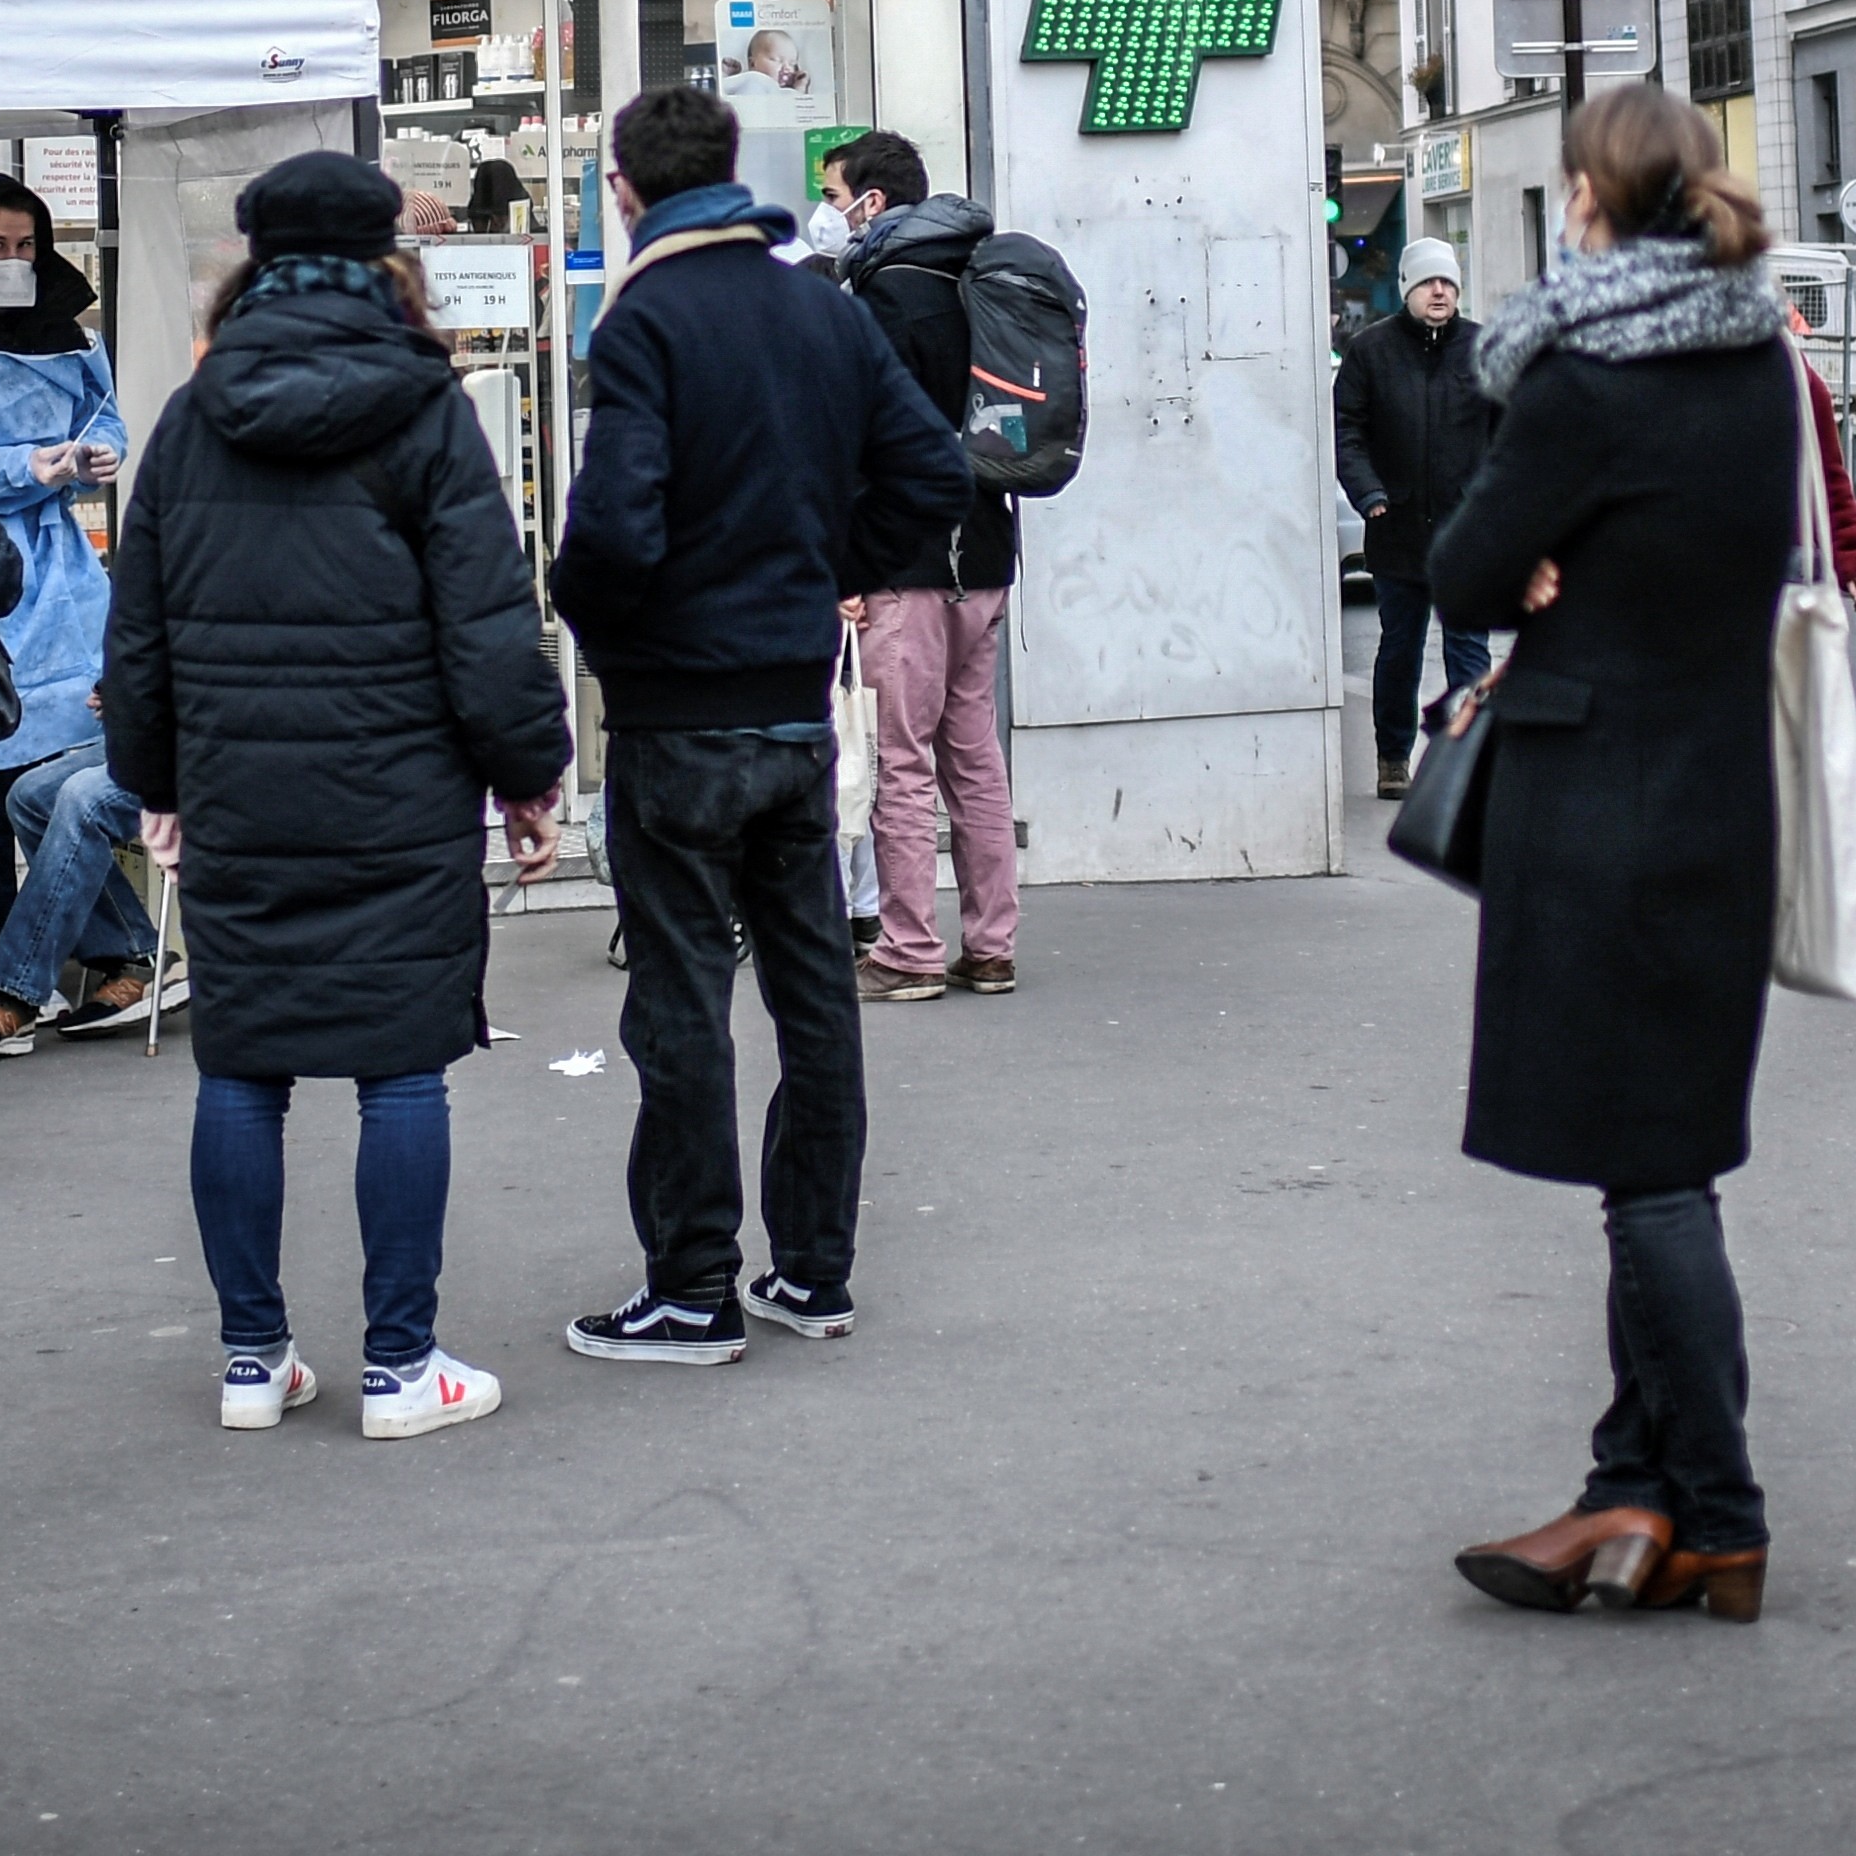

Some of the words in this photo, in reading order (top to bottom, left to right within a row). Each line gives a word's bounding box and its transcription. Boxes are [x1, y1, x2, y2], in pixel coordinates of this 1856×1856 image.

[432, 8, 489, 27] FILORGA
[43, 148, 63, 157] Pour
[65, 147, 80, 156] des
[49, 160, 83, 169] sécurité
[42, 173, 82, 183] respecter
[434, 271, 457, 281] TESTS
[458, 271, 517, 281] ANTIGENIQUES
[444, 295, 452, 306] 9
[453, 295, 462, 305] H
[483, 295, 496, 305] 19
[497, 295, 506, 305] H
[231, 1366, 260, 1377] VEJA
